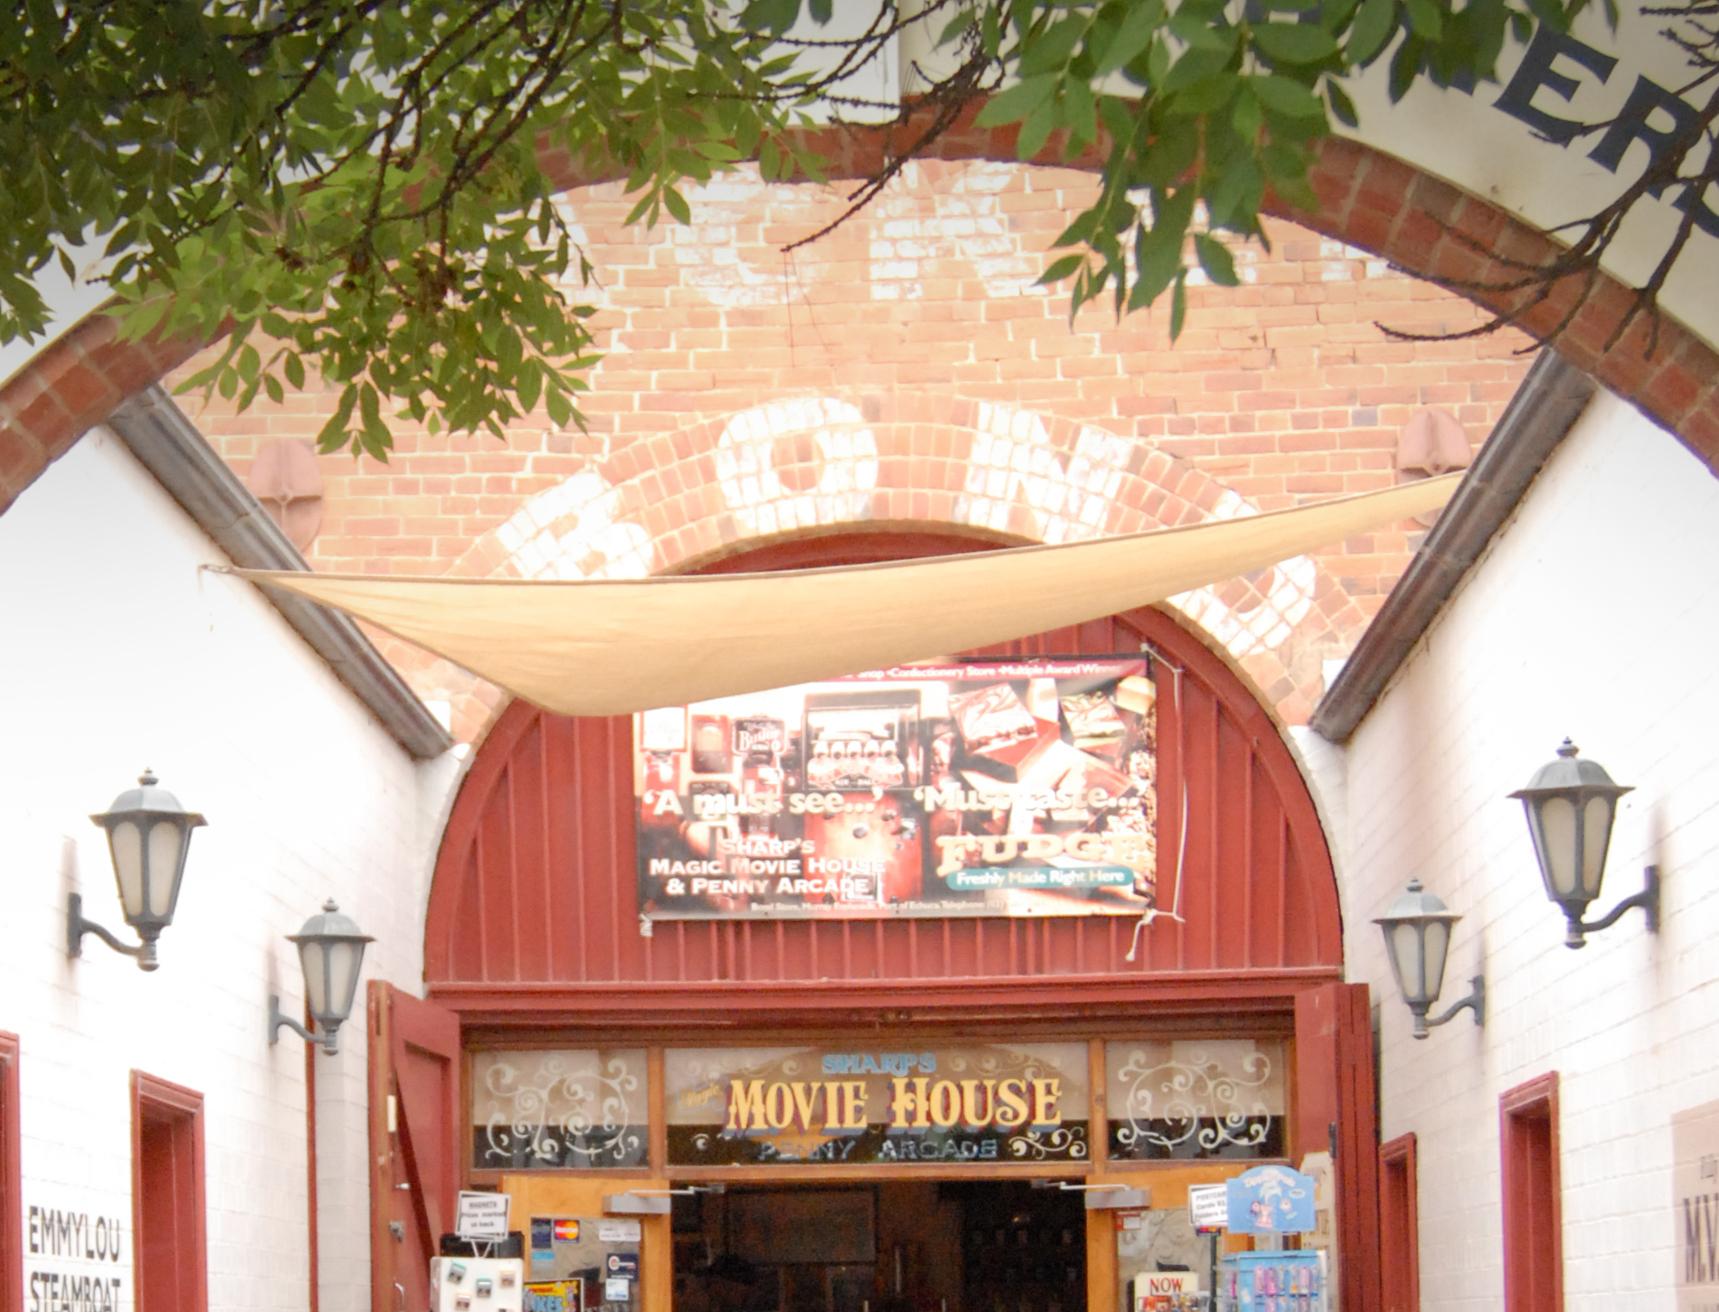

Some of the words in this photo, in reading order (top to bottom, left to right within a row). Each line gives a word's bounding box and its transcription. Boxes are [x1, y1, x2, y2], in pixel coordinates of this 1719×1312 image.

[693, 792, 783, 817] must
[935, 831, 1154, 877] FUDGE
[650, 858, 724, 876] MAGIC
[731, 858, 801, 875] MOVIE
[808, 857, 886, 874] HOUSE
[666, 877, 686, 896] &
[692, 878, 769, 895] PENNY
[776, 877, 870, 894] ARCADE
[957, 871, 1006, 889] Freshly
[1009, 872, 1047, 886] Made
[1050, 871, 1086, 887] Right
[1089, 870, 1126, 883] Here
[727, 1078, 869, 1131] MOVIE
[891, 1076, 1062, 1129] HOUSE
[878, 1138, 998, 1160] ARCADE
[28, 1204, 121, 1263] EMMYLOU
[1149, 1277, 1185, 1295] NOW
